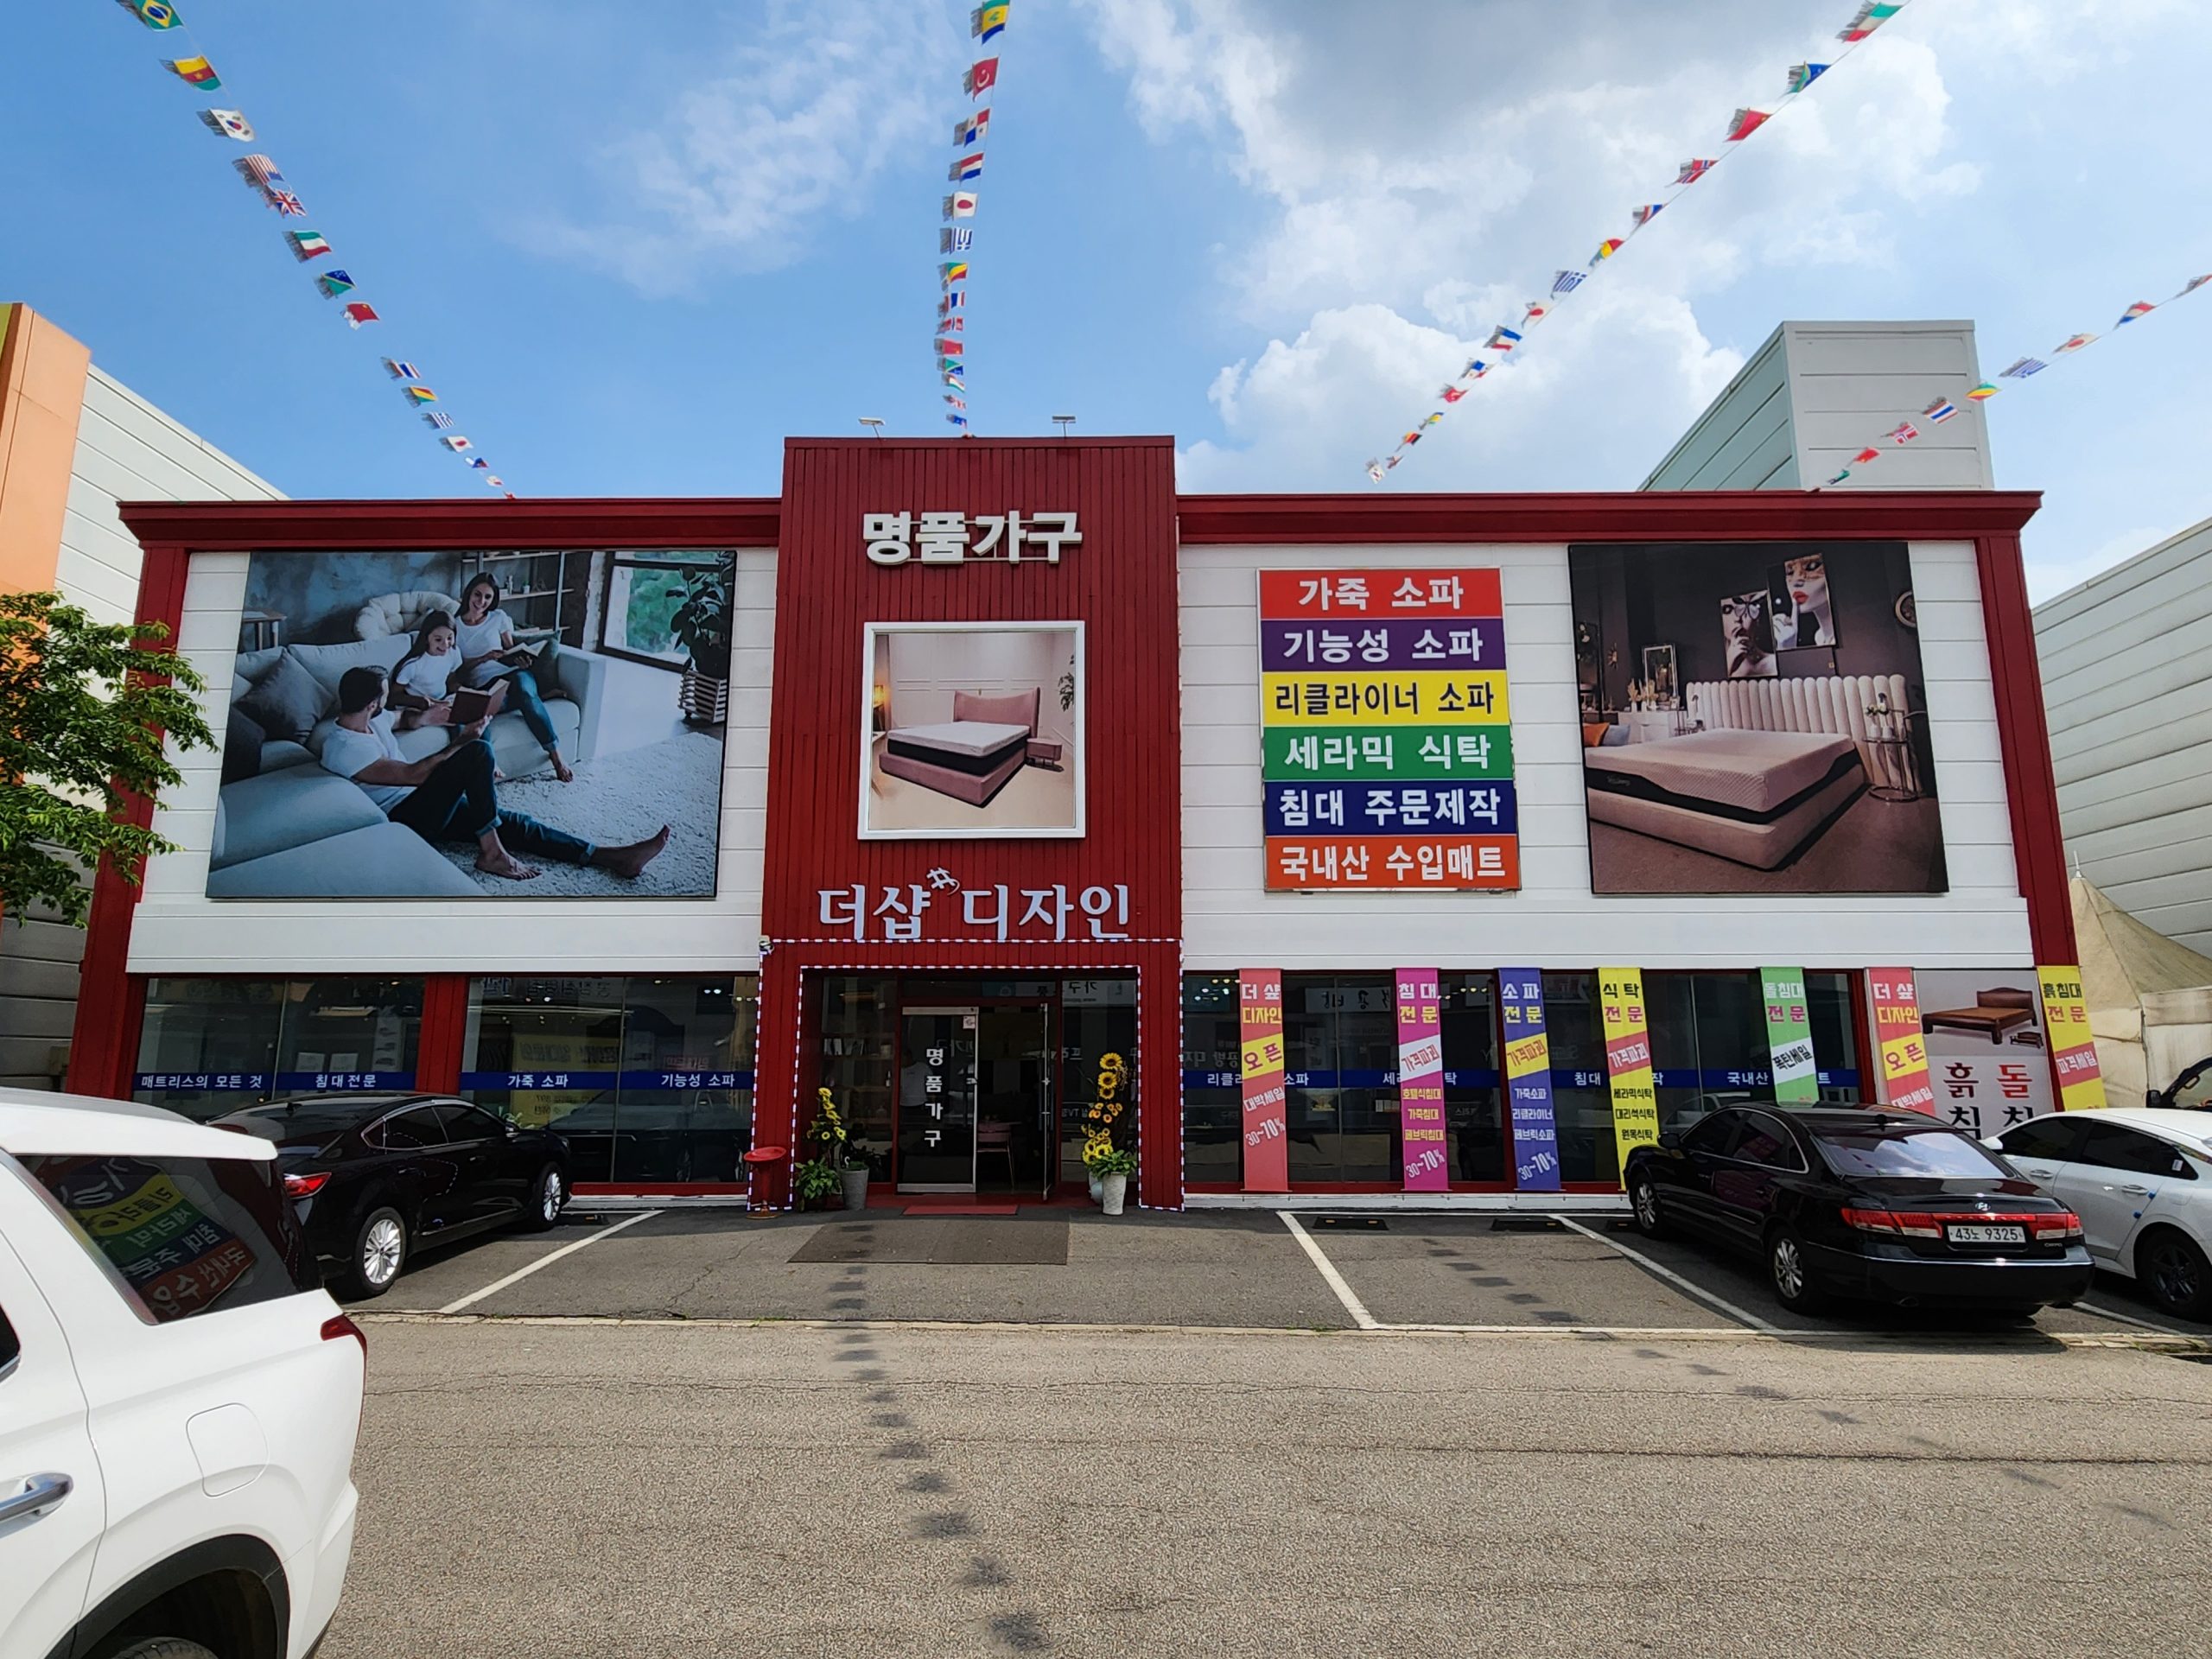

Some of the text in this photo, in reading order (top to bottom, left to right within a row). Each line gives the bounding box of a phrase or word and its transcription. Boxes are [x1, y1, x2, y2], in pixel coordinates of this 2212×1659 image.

[863, 511, 1083, 565] 명품가구
[1299, 575, 1464, 610] 가죽 소파
[1283, 627, 1483, 663] 기능성 소파
[1275, 681, 1494, 715] 리클라이너 소파
[1285, 734, 1491, 771] 세라믹 식탁
[1280, 788, 1501, 826] 침대 주문제작
[1280, 844, 1505, 881] 국내산 수입매트
[817, 883, 1128, 941] 더샵 디자인
[1398, 982, 1437, 1000] 침대
[1502, 983, 1540, 1000] 소파
[1603, 982, 1640, 999] 식탁
[2043, 982, 2083, 1000] 흙침대
[1243, 1007, 1282, 1024] 디자인
[1399, 1006, 1438, 1024] 전문
[1504, 1006, 1542, 1024] 전문
[1605, 1006, 1643, 1023] 전문
[1768, 1006, 1806, 1023] 전문
[1877, 1007, 1919, 1025] 디자인
[2048, 1006, 2087, 1024] 전문
[1244, 1042, 1282, 1071] 오픈
[1771, 1044, 1813, 1071] 폭탄세일
[1885, 1042, 1925, 1071] 오픈
[142, 1075, 262, 1089] 매트리스의 모든 것
[507, 1073, 569, 1088] 가죽 소파
[660, 1073, 734, 1088] 기능성 소파
[1574, 1072, 1601, 1085] 침대
[1727, 1072, 1769, 1085] 국내산
[1243, 1086, 1285, 1112] 대박세일
[1613, 1087, 1652, 1100] 세라믹식탁
[1512, 1109, 1554, 1120] 리클라이너
[1615, 1108, 1655, 1120] 대리석식탁
[1621, 1128, 1653, 1141] 원목식탁
[1985, 1228, 2018, 1241] 9325
